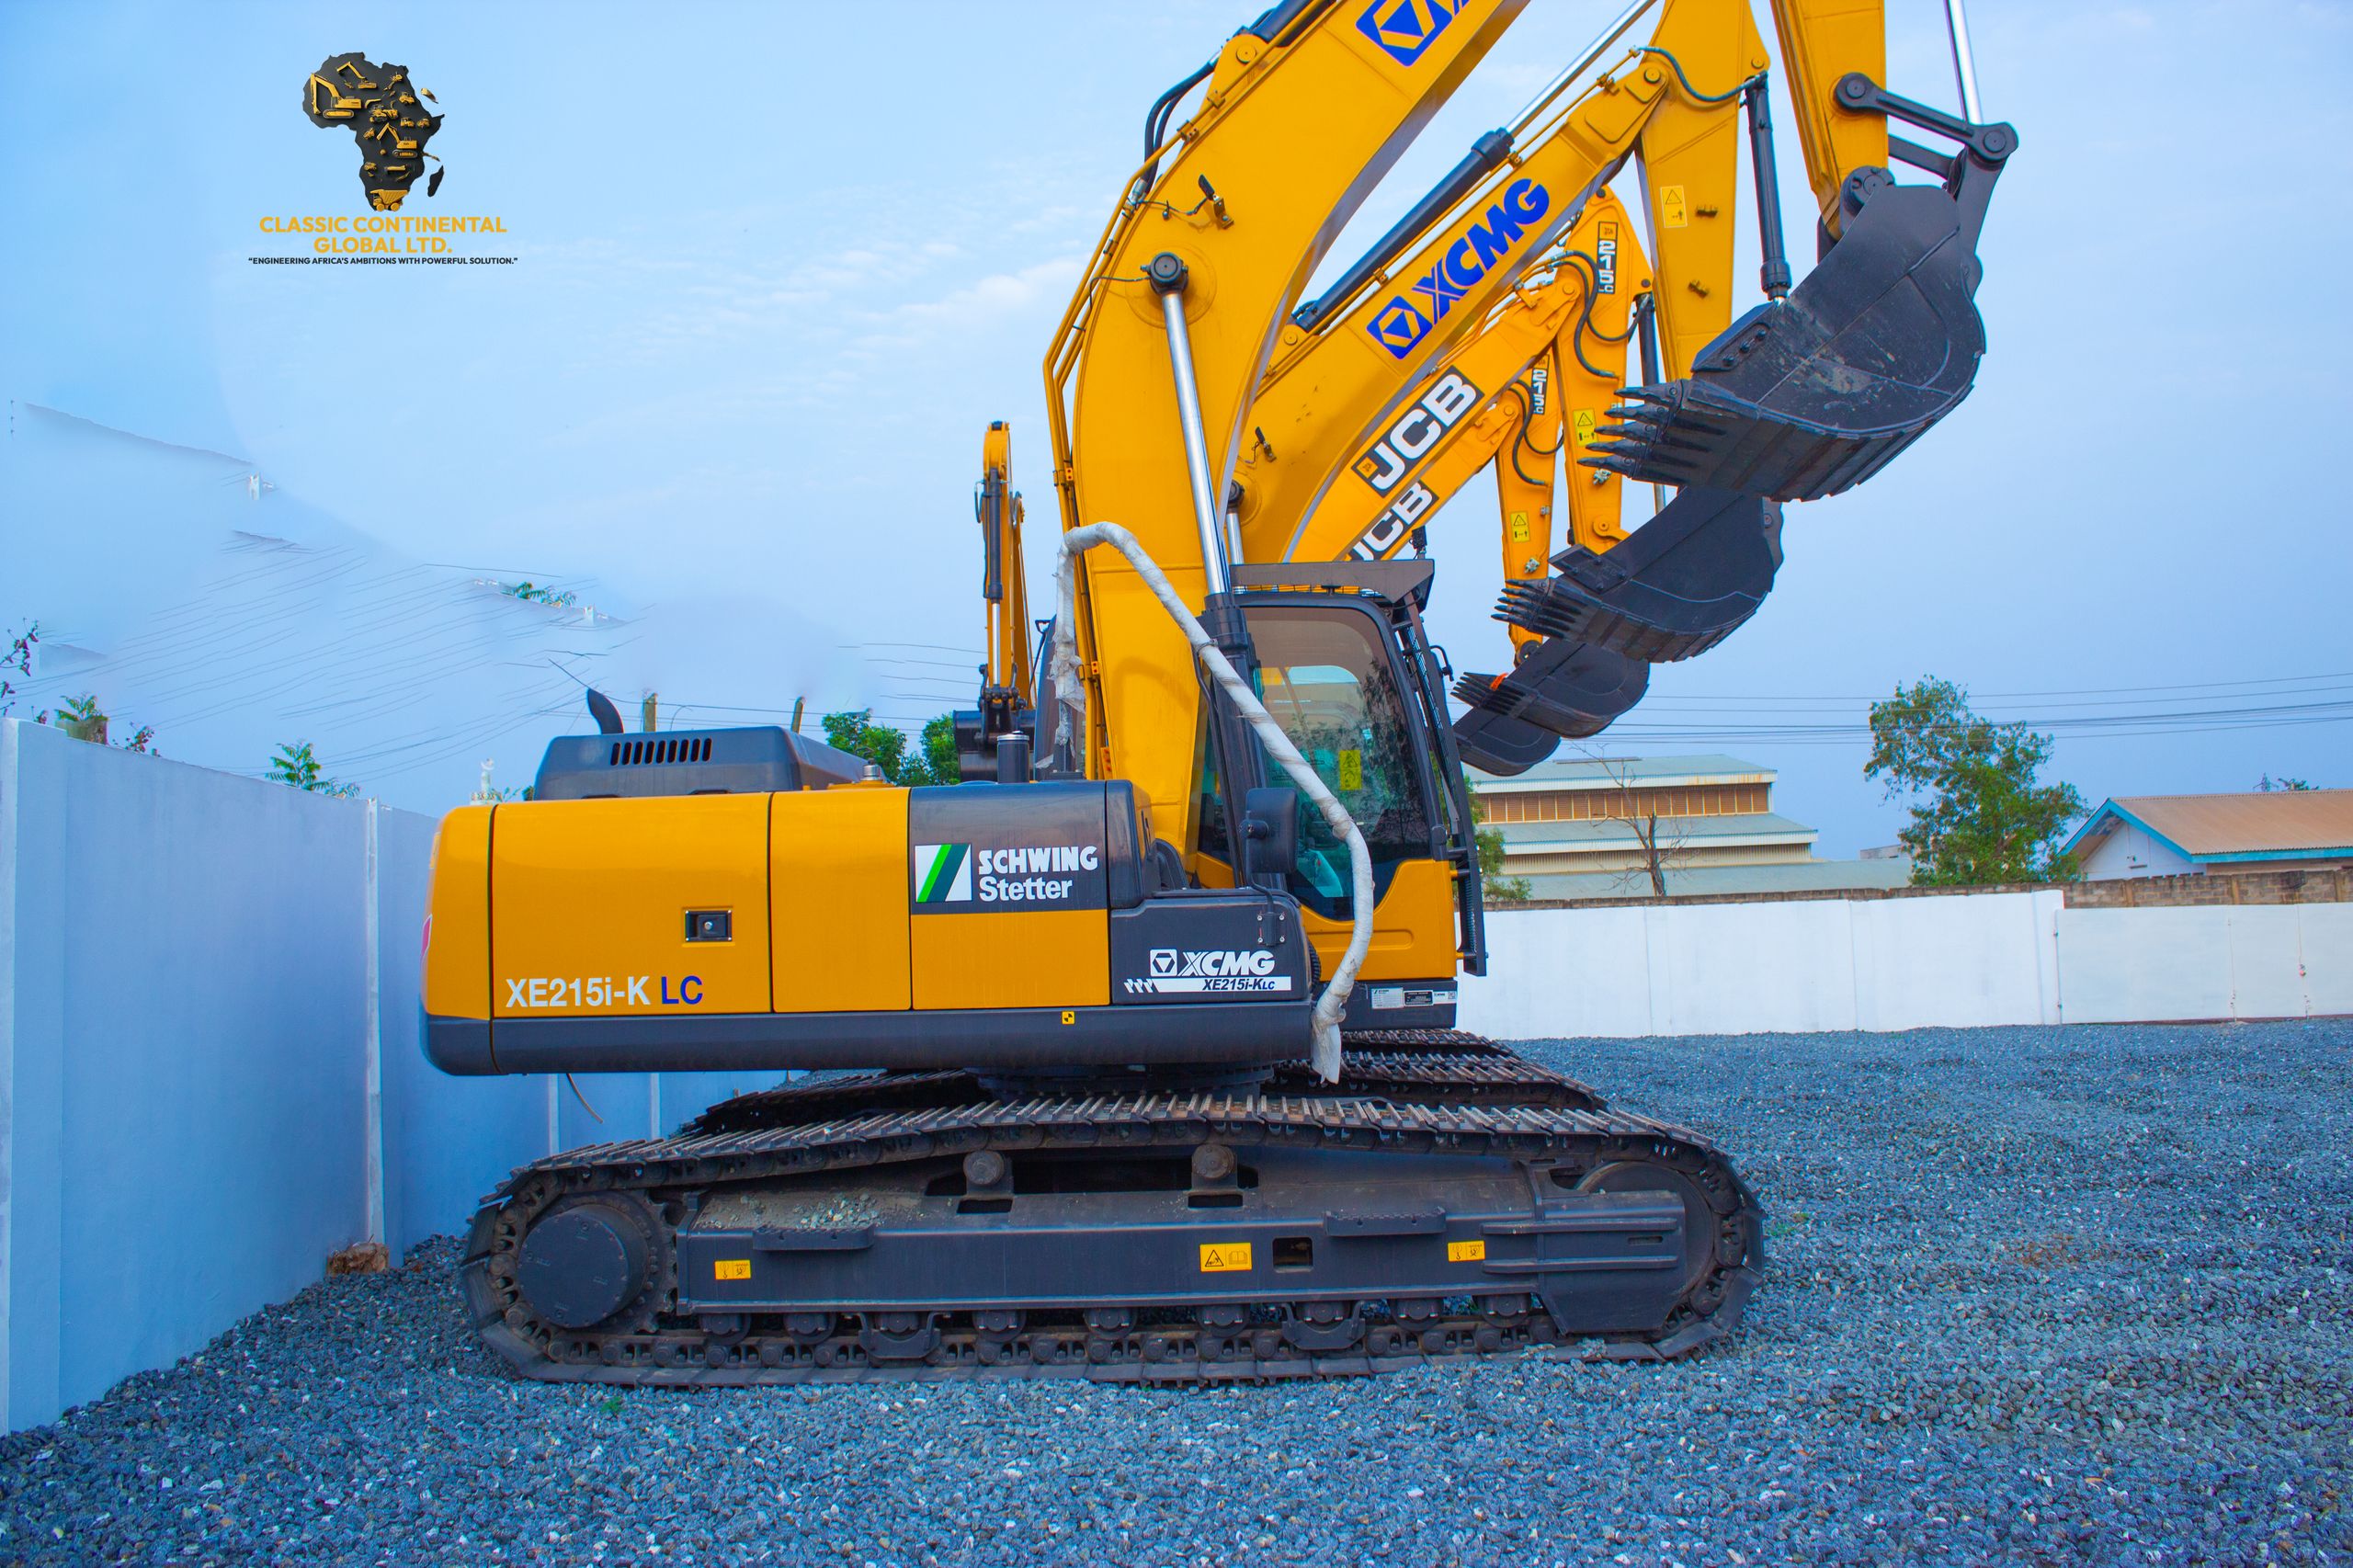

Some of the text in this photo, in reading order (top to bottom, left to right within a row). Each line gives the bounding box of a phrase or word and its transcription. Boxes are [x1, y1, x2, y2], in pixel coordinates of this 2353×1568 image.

[1411, 178, 1550, 324] XCMG
[1598, 240, 1617, 285] 215
[1371, 374, 1476, 490] JCB
[978, 846, 1098, 874] SCHWING
[979, 876, 1073, 902] Stetter
[1177, 950, 1275, 976] XCMG
[506, 975, 703, 1007] XE215i-K LC
